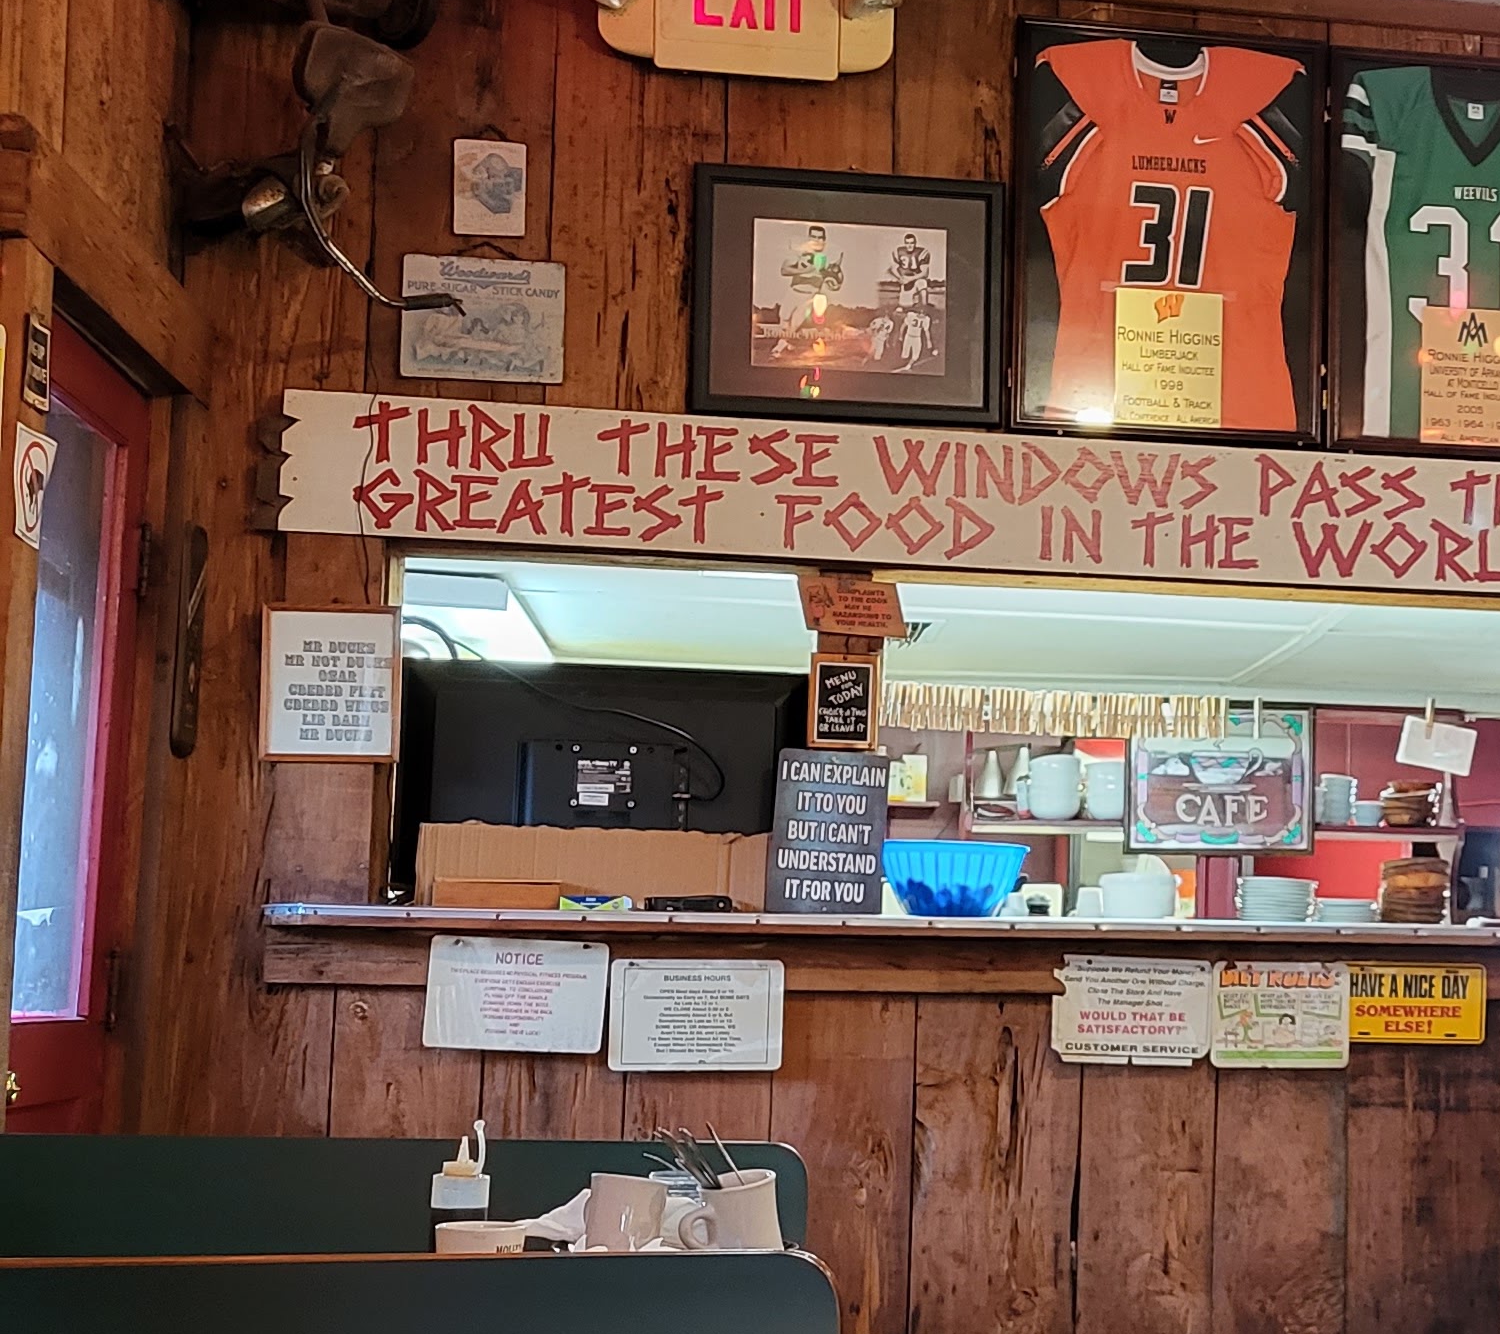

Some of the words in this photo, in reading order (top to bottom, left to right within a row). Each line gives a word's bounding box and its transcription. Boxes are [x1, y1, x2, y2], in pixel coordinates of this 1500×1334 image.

[1131, 154, 1207, 175] LUMBERJACKS
[1453, 186, 1498, 202] WEEVILS
[1119, 180, 1215, 289] 31
[407, 279, 436, 292] PURE
[440, 282, 478, 294] SUGAR
[492, 285, 523, 298] STICK
[525, 287, 561, 300] CANDY
[1153, 378, 1184, 392] 1998
[352, 401, 554, 473] THRU
[597, 417, 841, 488] THESE
[872, 434, 1217, 509] WINDOWS
[1255, 453, 1426, 521] PASS
[352, 468, 725, 544] GREATEST
[774, 492, 995, 561] FOOD
[1039, 503, 1103, 564] IN
[1130, 511, 1259, 570] THE
[328, 640, 376, 655] DUCKS
[311, 654, 341, 668] NOT
[824, 670, 857, 689] MENU
[827, 683, 864, 706] TODAY
[831, 724, 855, 733] LEAVE
[856, 724, 866, 733] IT
[782, 760, 788, 780] I
[790, 761, 821, 783] CAN
[823, 763, 887, 788] EXPLAIN
[797, 791, 813, 811] IT
[814, 792, 834, 813] TO
[836, 793, 868, 815] YOU
[1175, 793, 1269, 827] CAFE
[787, 819, 819, 841] BUT
[819, 822, 826, 842] I
[828, 822, 872, 845] CAN'T
[777, 847, 877, 875] UNDERSTAND
[784, 878, 801, 899] IT
[801, 879, 832, 902] FOR
[833, 880, 865, 904] YOU
[495, 951, 545, 966] NOTICE
[663, 974, 703, 982] BUSINESS
[703, 974, 732, 982] HOURS
[1349, 973, 1387, 999] HAVE
[1388, 973, 1399, 998] A
[1403, 973, 1437, 1000] NICE
[1441, 974, 1470, 1000] DAY
[1079, 1010, 1128, 1021] WOULD
[1130, 1011, 1166, 1022] THAT
[1168, 1012, 1187, 1022] BE
[1355, 1004, 1462, 1019] SOMEWHERE
[1384, 1020, 1433, 1035] ELSE!
[1064, 1042, 1138, 1053] CUSTOMER
[1142, 1043, 1199, 1054] SERVICE
